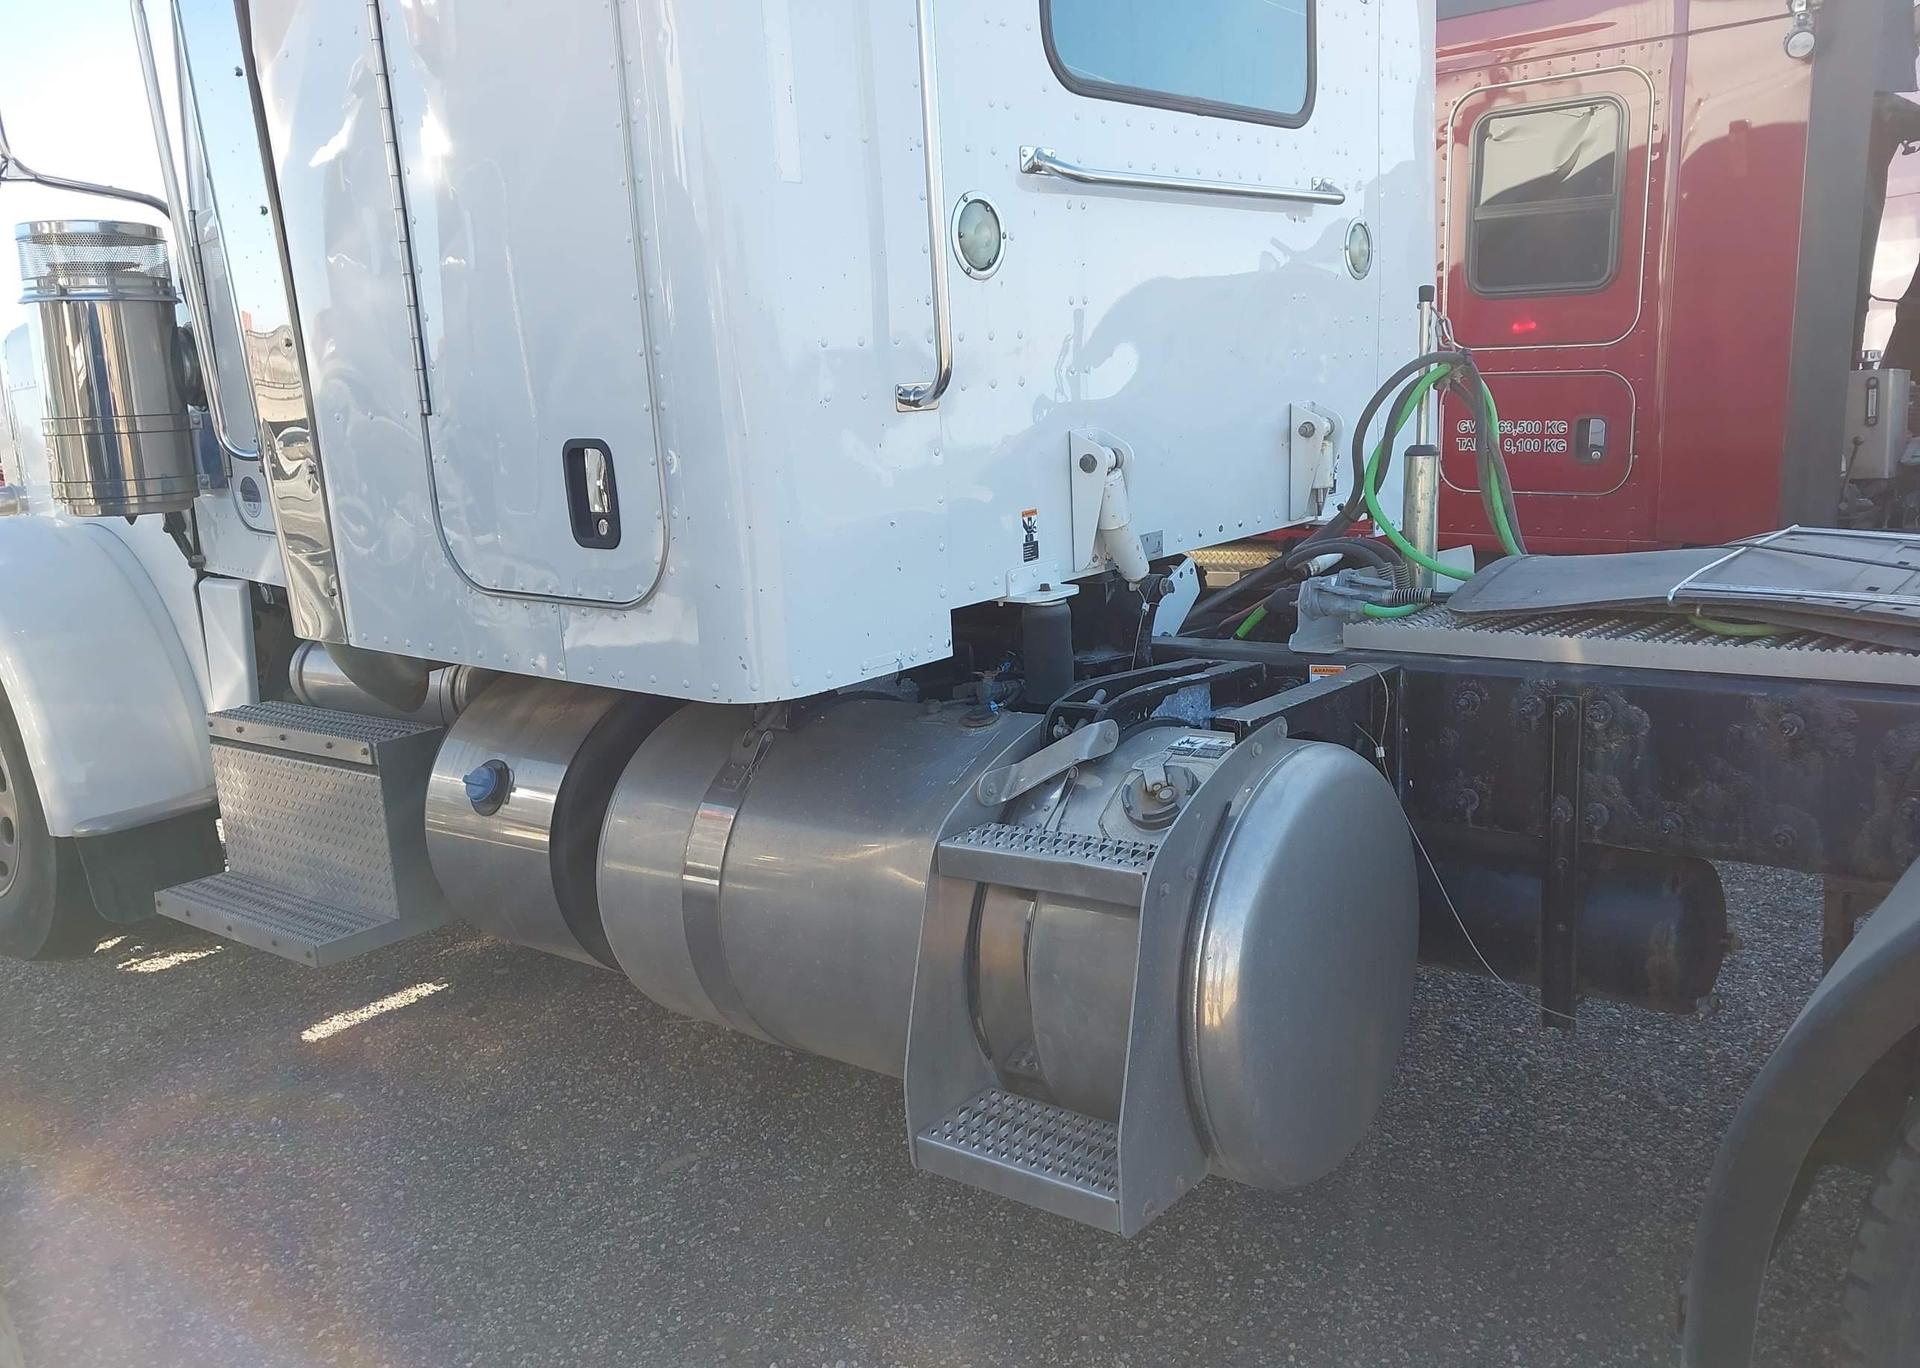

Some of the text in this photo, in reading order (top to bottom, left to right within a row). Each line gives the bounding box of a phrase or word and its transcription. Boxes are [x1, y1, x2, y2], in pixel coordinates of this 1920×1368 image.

[1457, 420, 1568, 436] GV 63,500 KG
[1504, 438, 1541, 454] 9,100
[1544, 438, 1567, 452] KG
